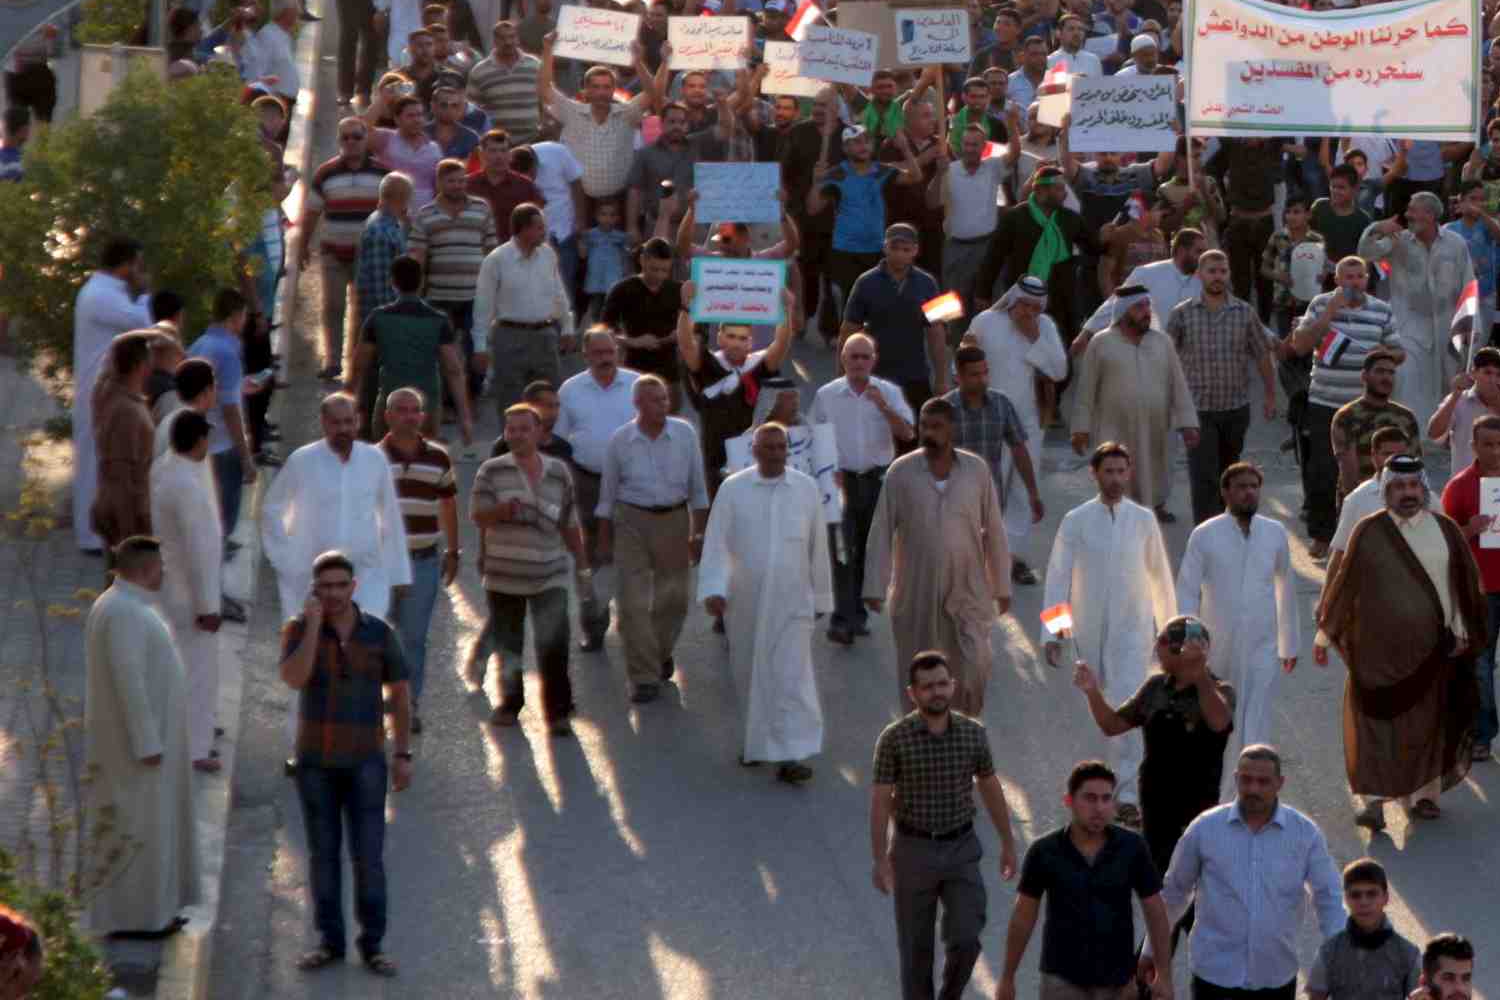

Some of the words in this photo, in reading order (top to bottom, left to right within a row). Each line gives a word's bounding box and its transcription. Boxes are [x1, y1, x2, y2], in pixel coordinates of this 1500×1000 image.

[1278, 29, 1305, 47] من
[1309, 28, 1365, 50] الوطن
[1240, 61, 1320, 84] المفسدين
[1323, 66, 1350, 86] من
